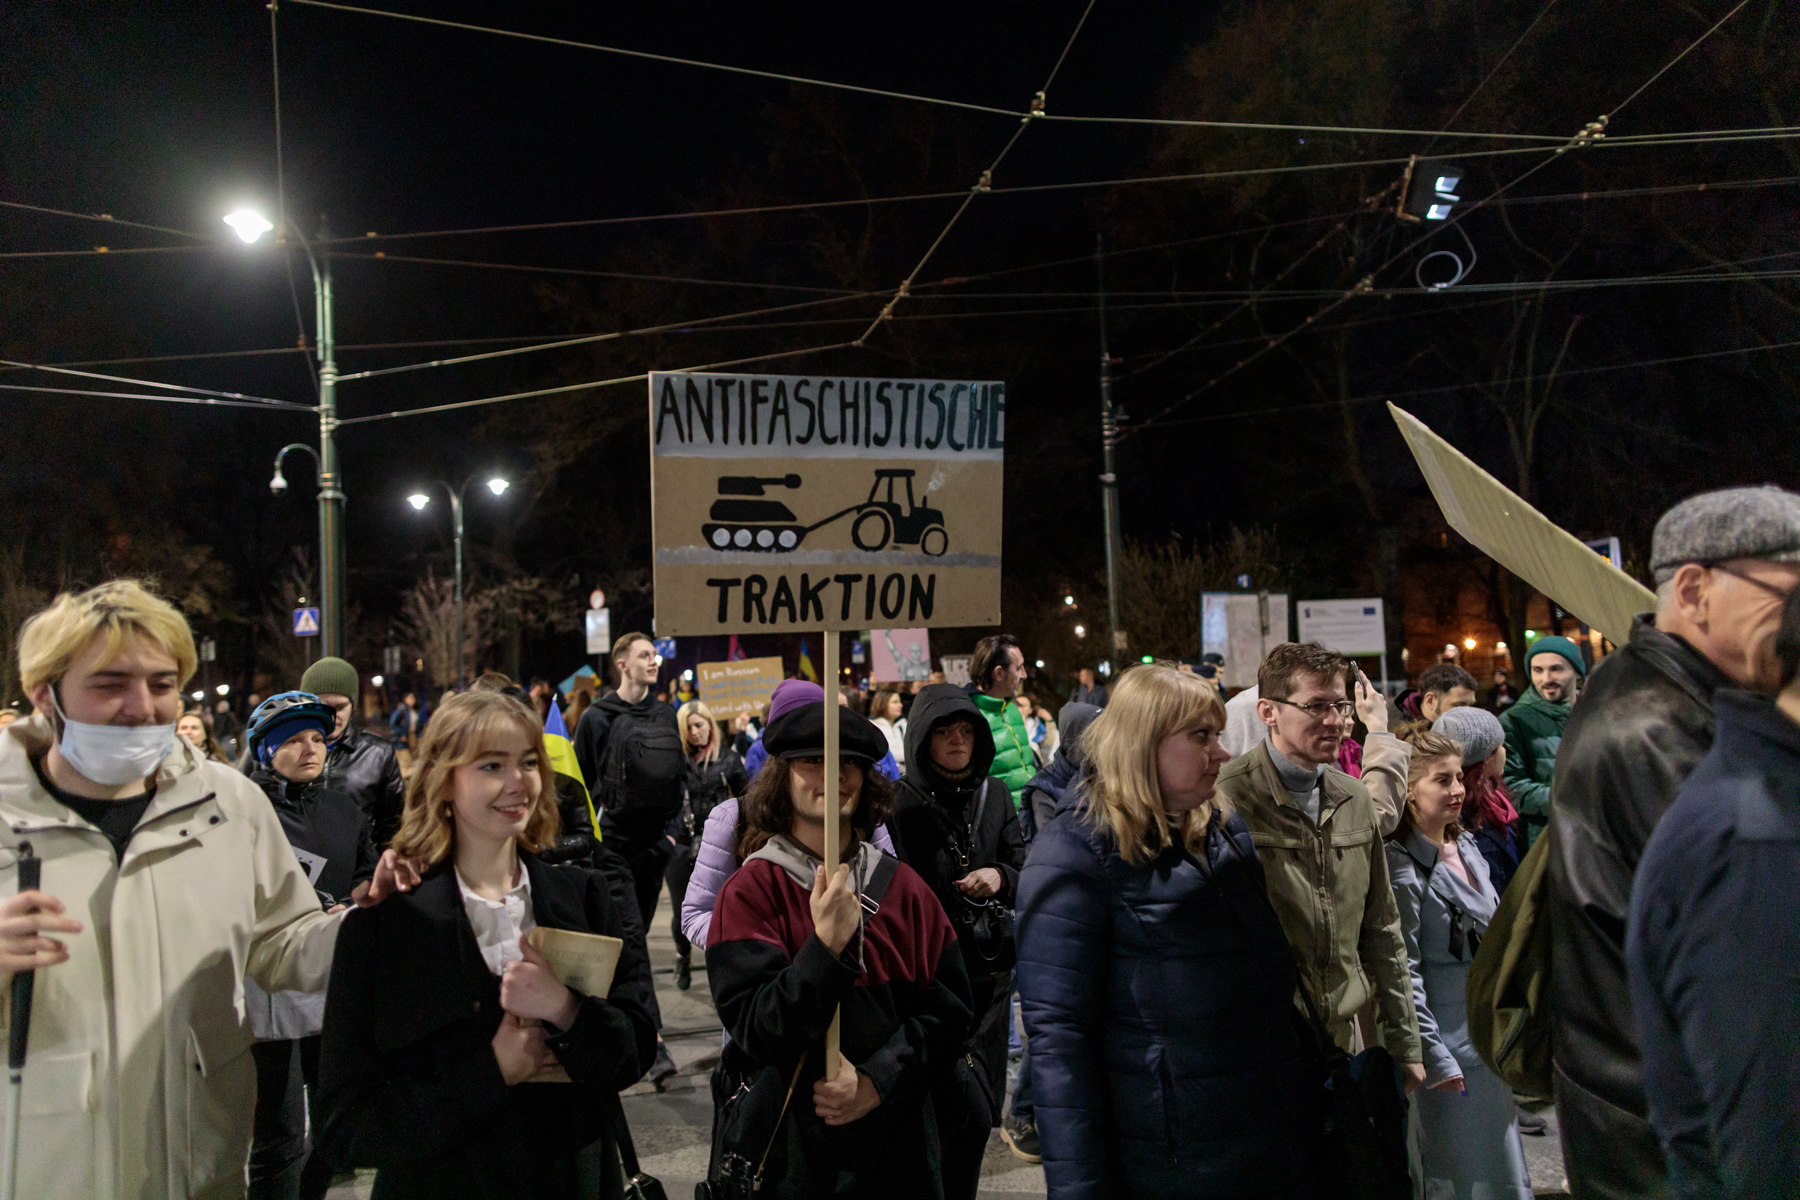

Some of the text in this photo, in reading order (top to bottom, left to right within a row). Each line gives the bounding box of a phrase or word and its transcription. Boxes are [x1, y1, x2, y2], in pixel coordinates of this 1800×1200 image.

[656, 377, 1005, 451] ANTIFASCHISTISCHE
[706, 573, 936, 624] TRAKTION
[711, 671, 724, 679] am
